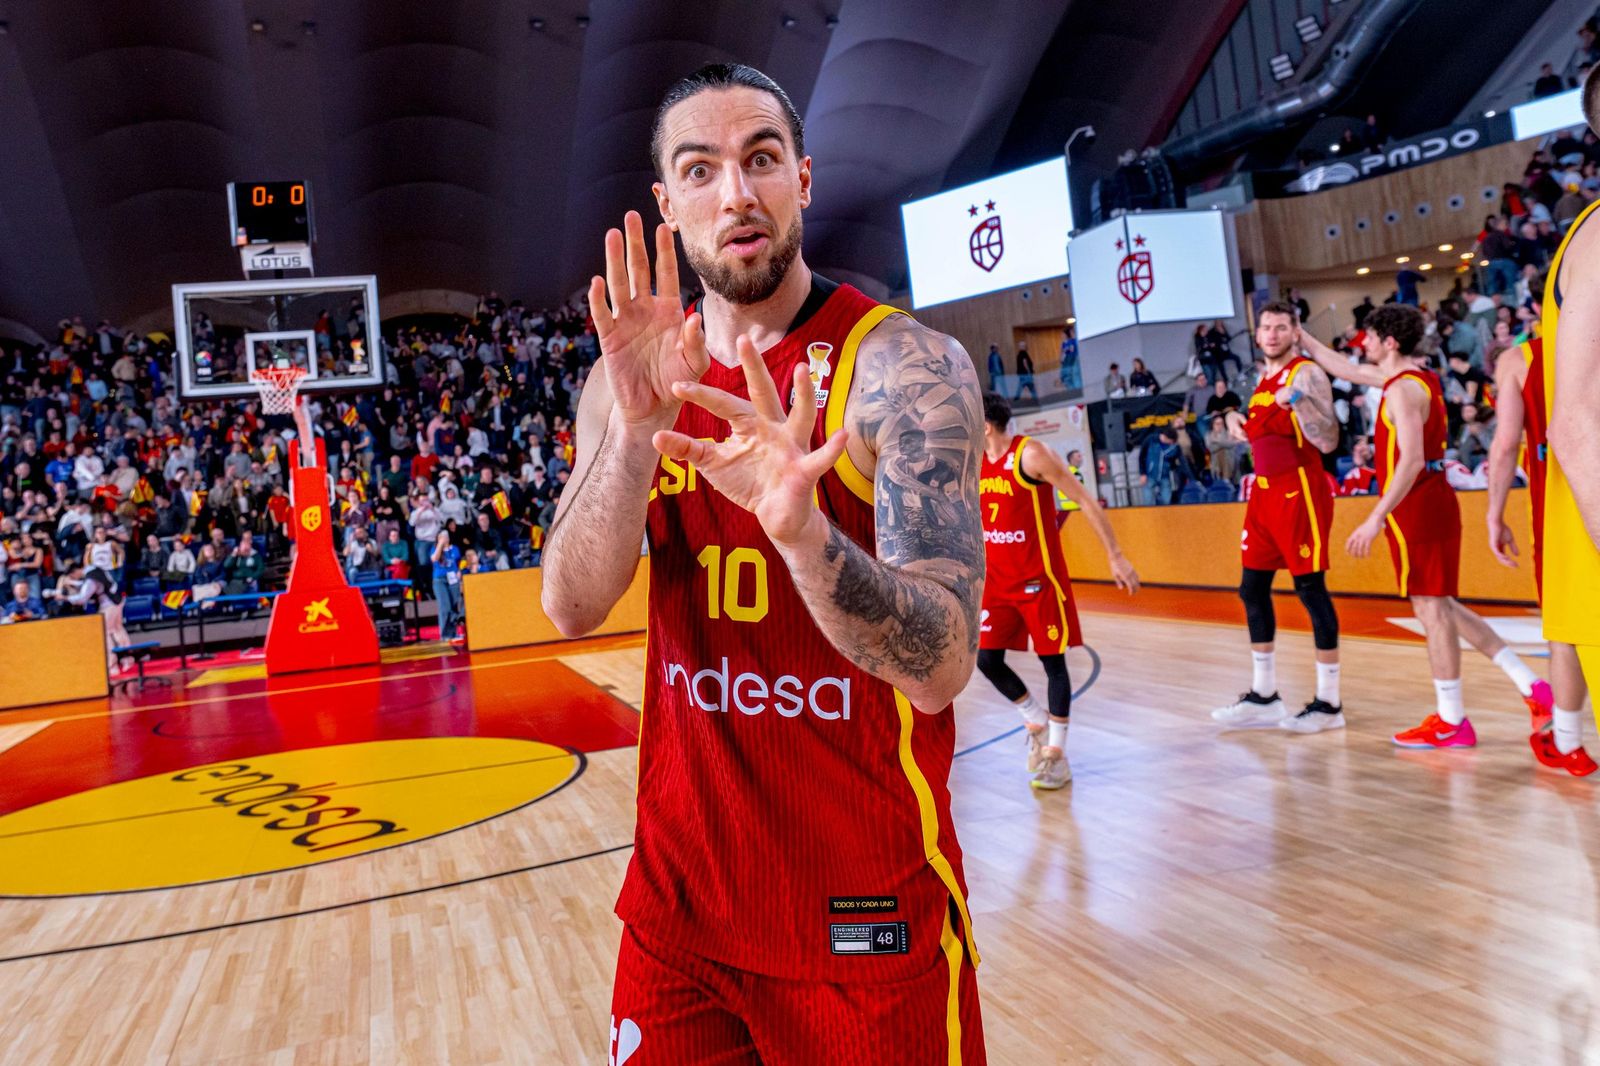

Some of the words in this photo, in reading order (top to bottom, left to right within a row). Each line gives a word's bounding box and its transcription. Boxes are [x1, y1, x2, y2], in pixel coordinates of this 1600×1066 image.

[290, 185, 304, 205] 0
[251, 256, 302, 269] LOTUS
[988, 503, 999, 523] 7
[697, 544, 769, 623] 10
[663, 656, 850, 720] ndesa
[171, 764, 408, 853] endesa
[877, 932, 893, 945] 48
